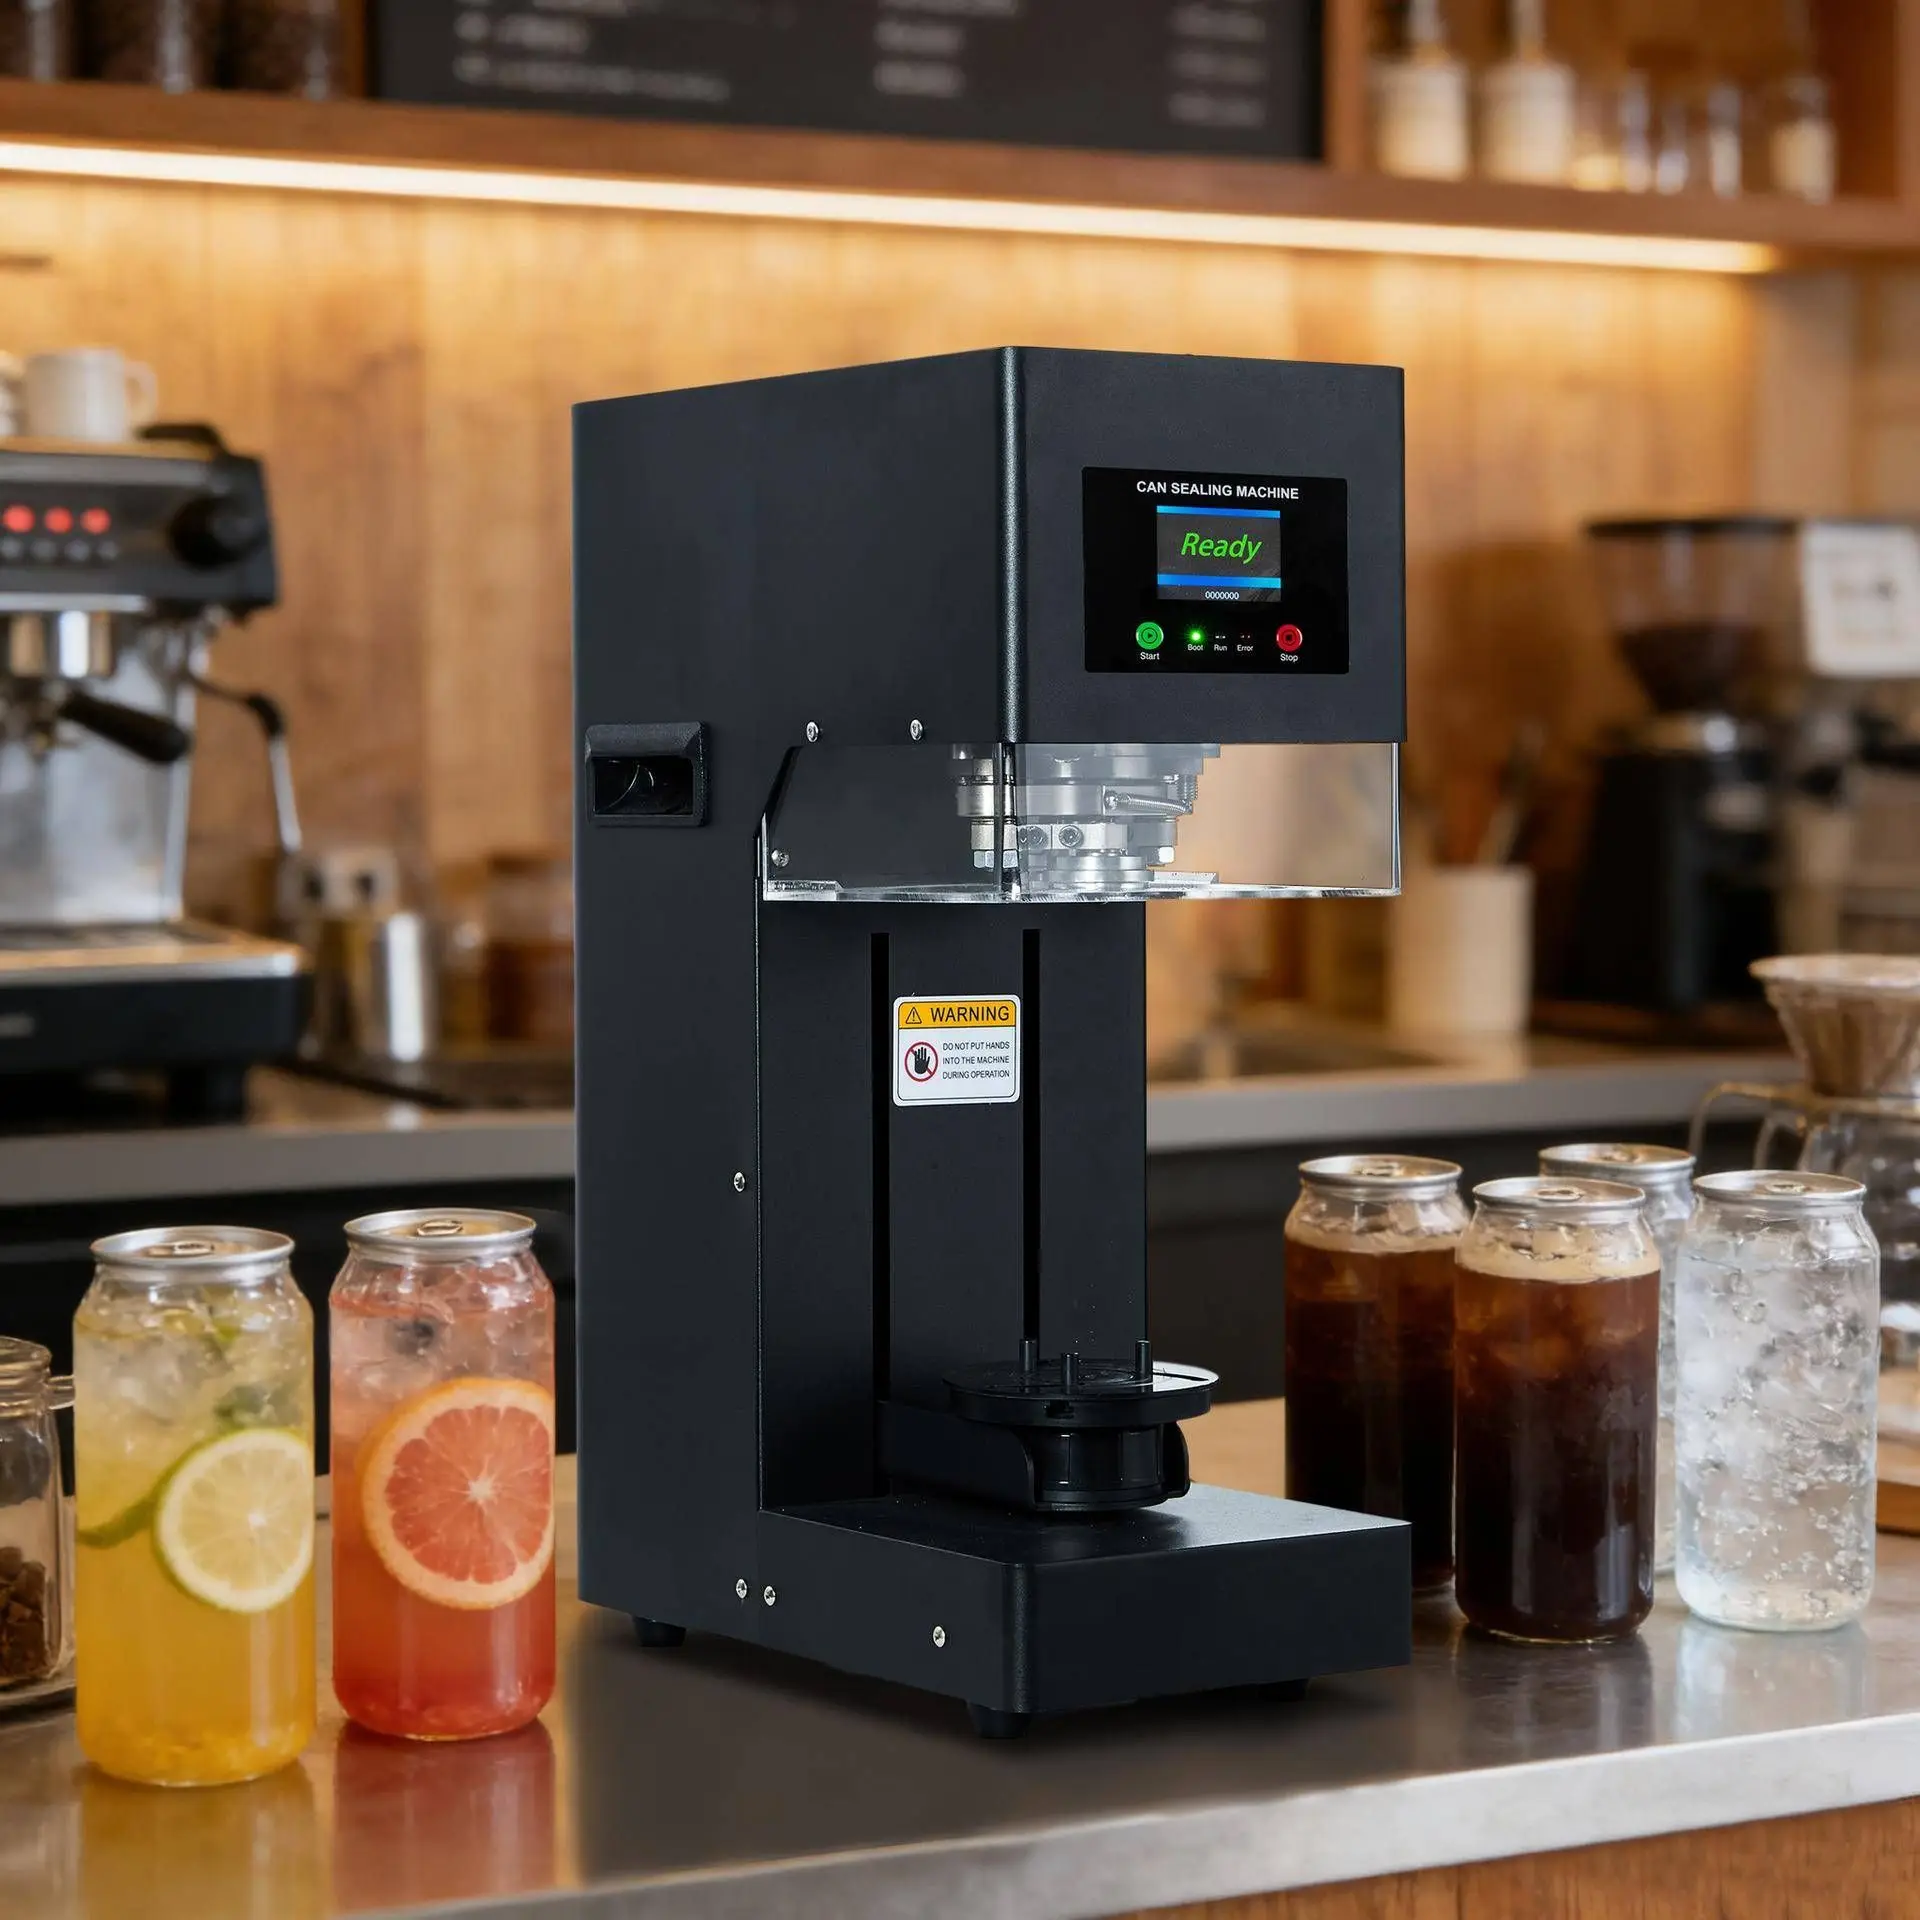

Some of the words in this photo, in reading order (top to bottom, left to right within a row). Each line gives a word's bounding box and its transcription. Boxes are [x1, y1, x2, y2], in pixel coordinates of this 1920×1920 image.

[1136, 481, 1167, 494] CAN
[1171, 482, 1232, 497] SEALING
[1236, 485, 1299, 499] MACHINE
[1181, 532, 1262, 564] Ready
[1140, 651, 1160, 660] Start
[1280, 653, 1299, 662] Stop
[930, 1006, 1010, 1022] WARNING
[943, 1043, 953, 1051] DO
[955, 1042, 969, 1050] NOT
[971, 1041, 984, 1050] PUT
[986, 1041, 1010, 1049] HANDS
[943, 1057, 960, 1065] INTO
[962, 1056, 975, 1064] THE
[977, 1056, 1010, 1064] MACHINE
[943, 1071, 969, 1079] DURING
[971, 1070, 1010, 1079] OPERATION
